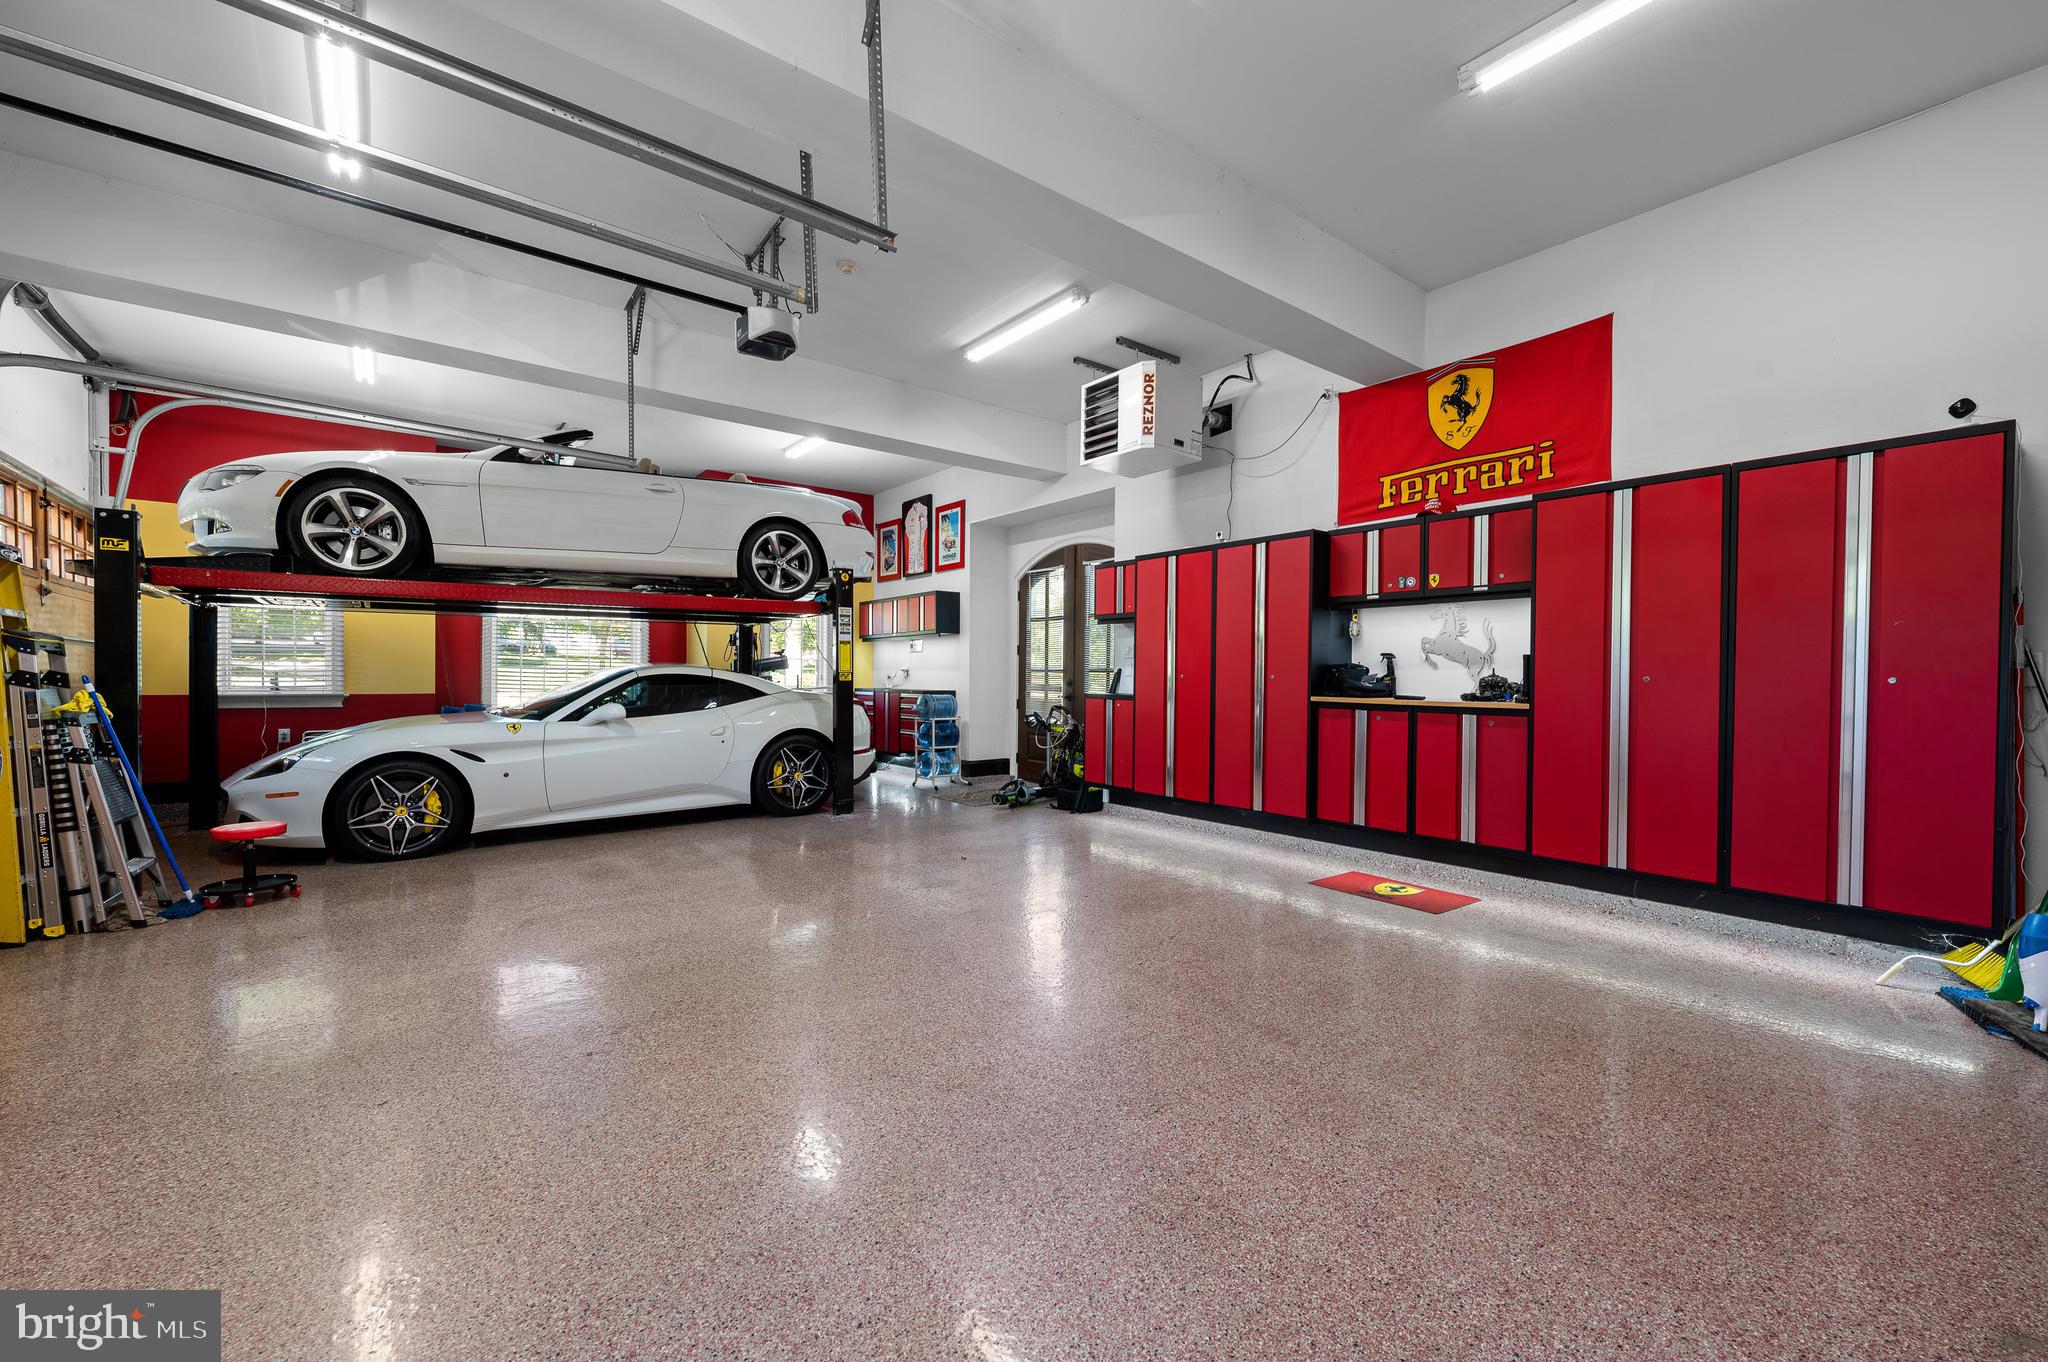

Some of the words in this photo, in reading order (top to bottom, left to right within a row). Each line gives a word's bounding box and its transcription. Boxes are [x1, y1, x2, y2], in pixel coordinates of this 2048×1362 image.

[1142, 373, 1155, 436] REZNOR
[1377, 440, 1555, 510] Ferrari
[38, 813, 48, 836] GORILLA
[41, 843, 51, 867] LADDERS
